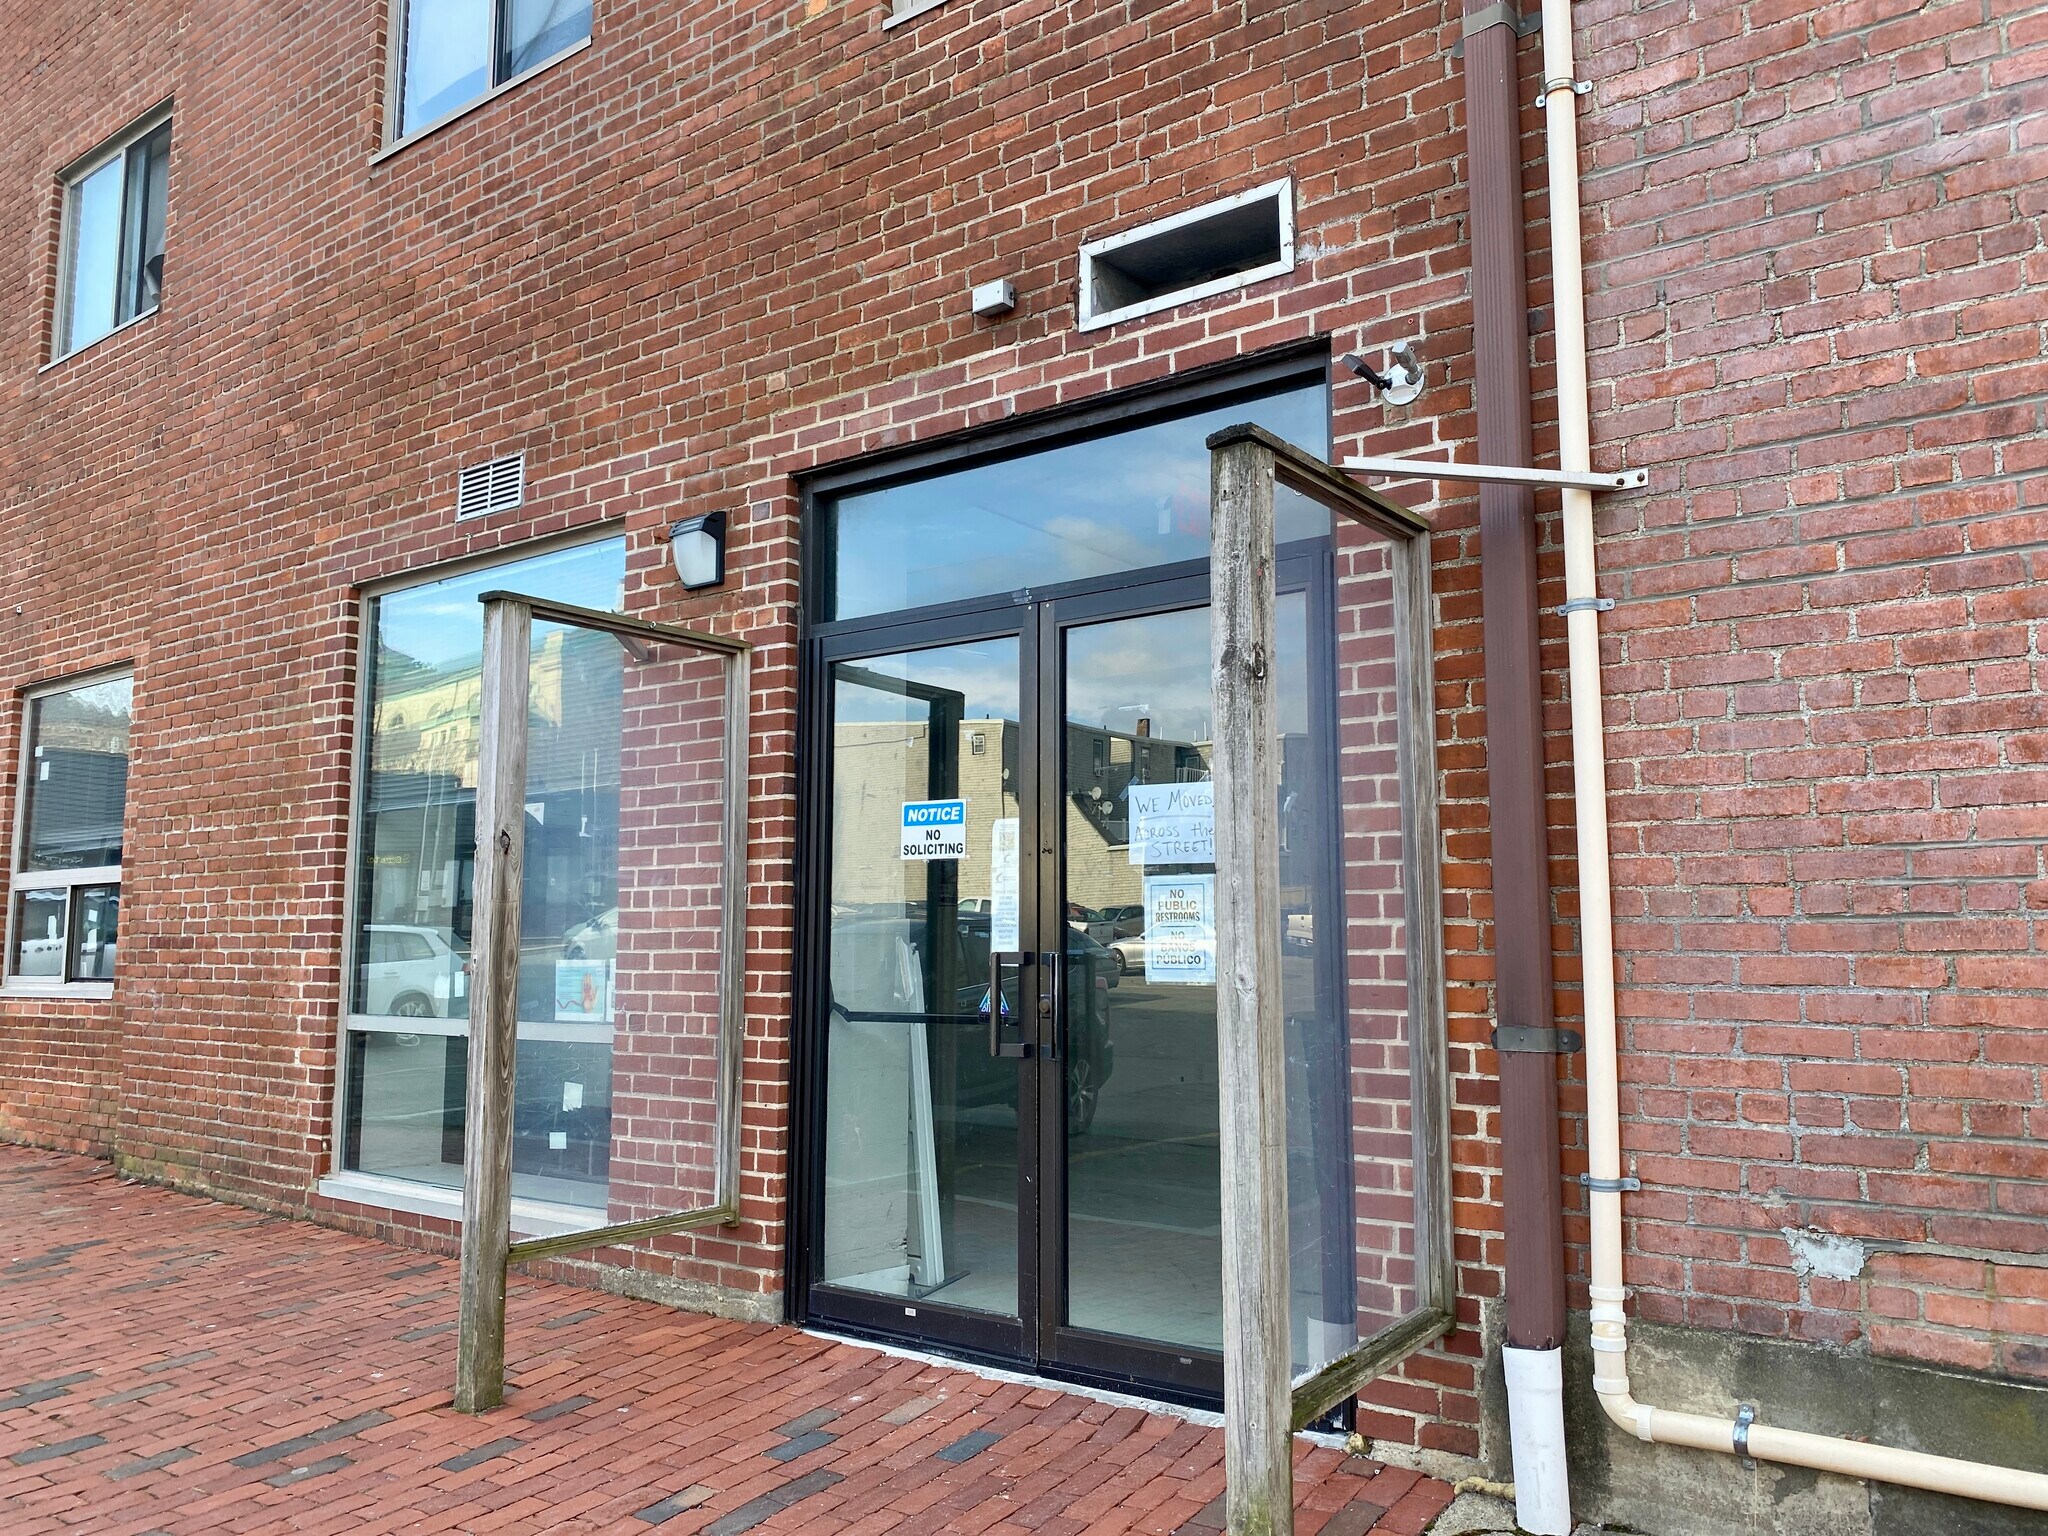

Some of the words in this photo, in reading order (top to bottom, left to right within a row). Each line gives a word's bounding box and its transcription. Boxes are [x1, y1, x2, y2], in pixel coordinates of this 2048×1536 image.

[1134, 796, 1160, 813] WE
[907, 806, 961, 823] NOTICE
[925, 829, 941, 841] NO
[1134, 826, 1180, 842] ACROSS
[903, 842, 964, 856] SOLICITING
[1150, 838, 1213, 858] STREET!
[1169, 889, 1185, 899] NO
[1158, 901, 1197, 911] PUBLIC
[1155, 912, 1201, 923] RESTROOMS
[1170, 930, 1185, 940] NO
